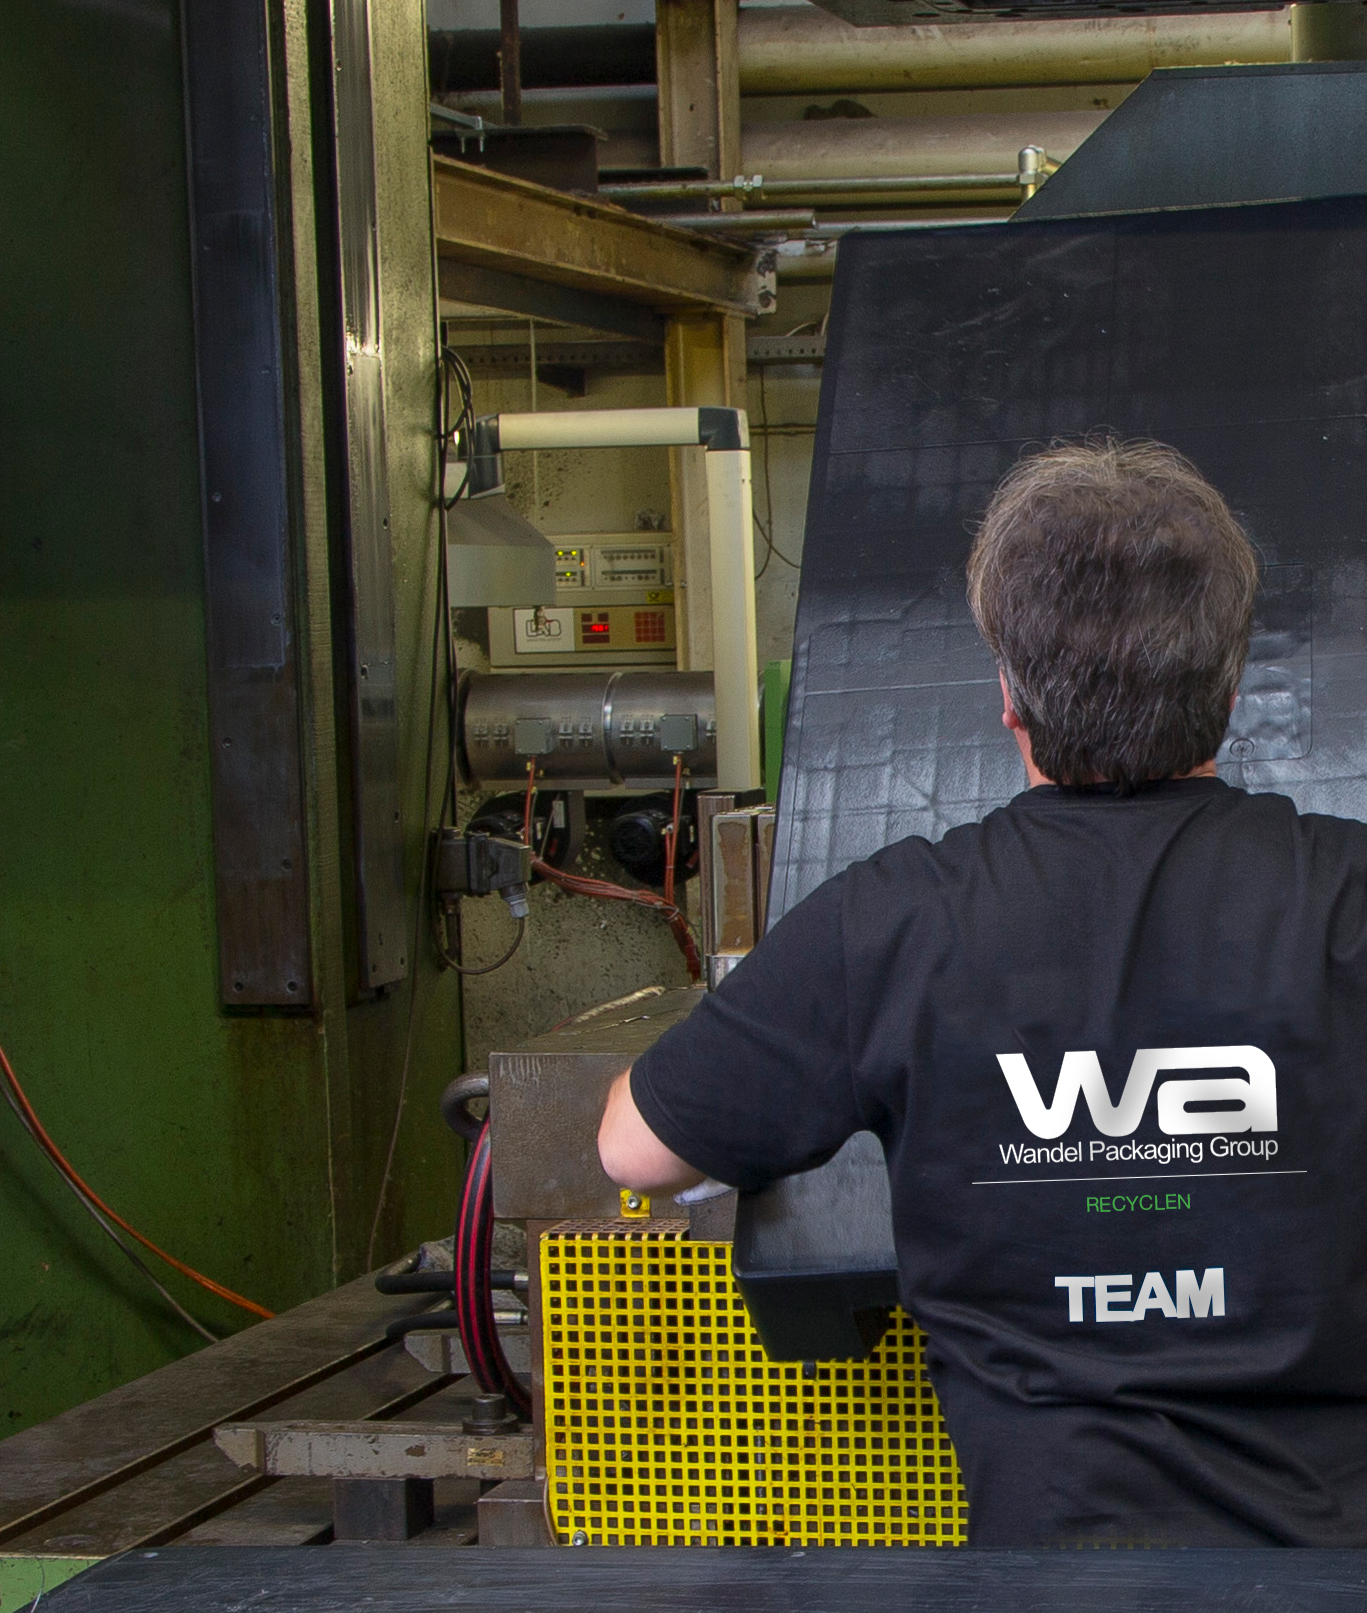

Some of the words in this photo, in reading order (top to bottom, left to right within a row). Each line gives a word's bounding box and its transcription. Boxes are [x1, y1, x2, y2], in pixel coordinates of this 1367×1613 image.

[999, 1141, 1083, 1165] Wandel
[1089, 1138, 1204, 1164] Packaging
[1209, 1135, 1279, 1161] Group
[1086, 1193, 1191, 1213] RECYCLEN
[1054, 1267, 1226, 1323] TEAM
